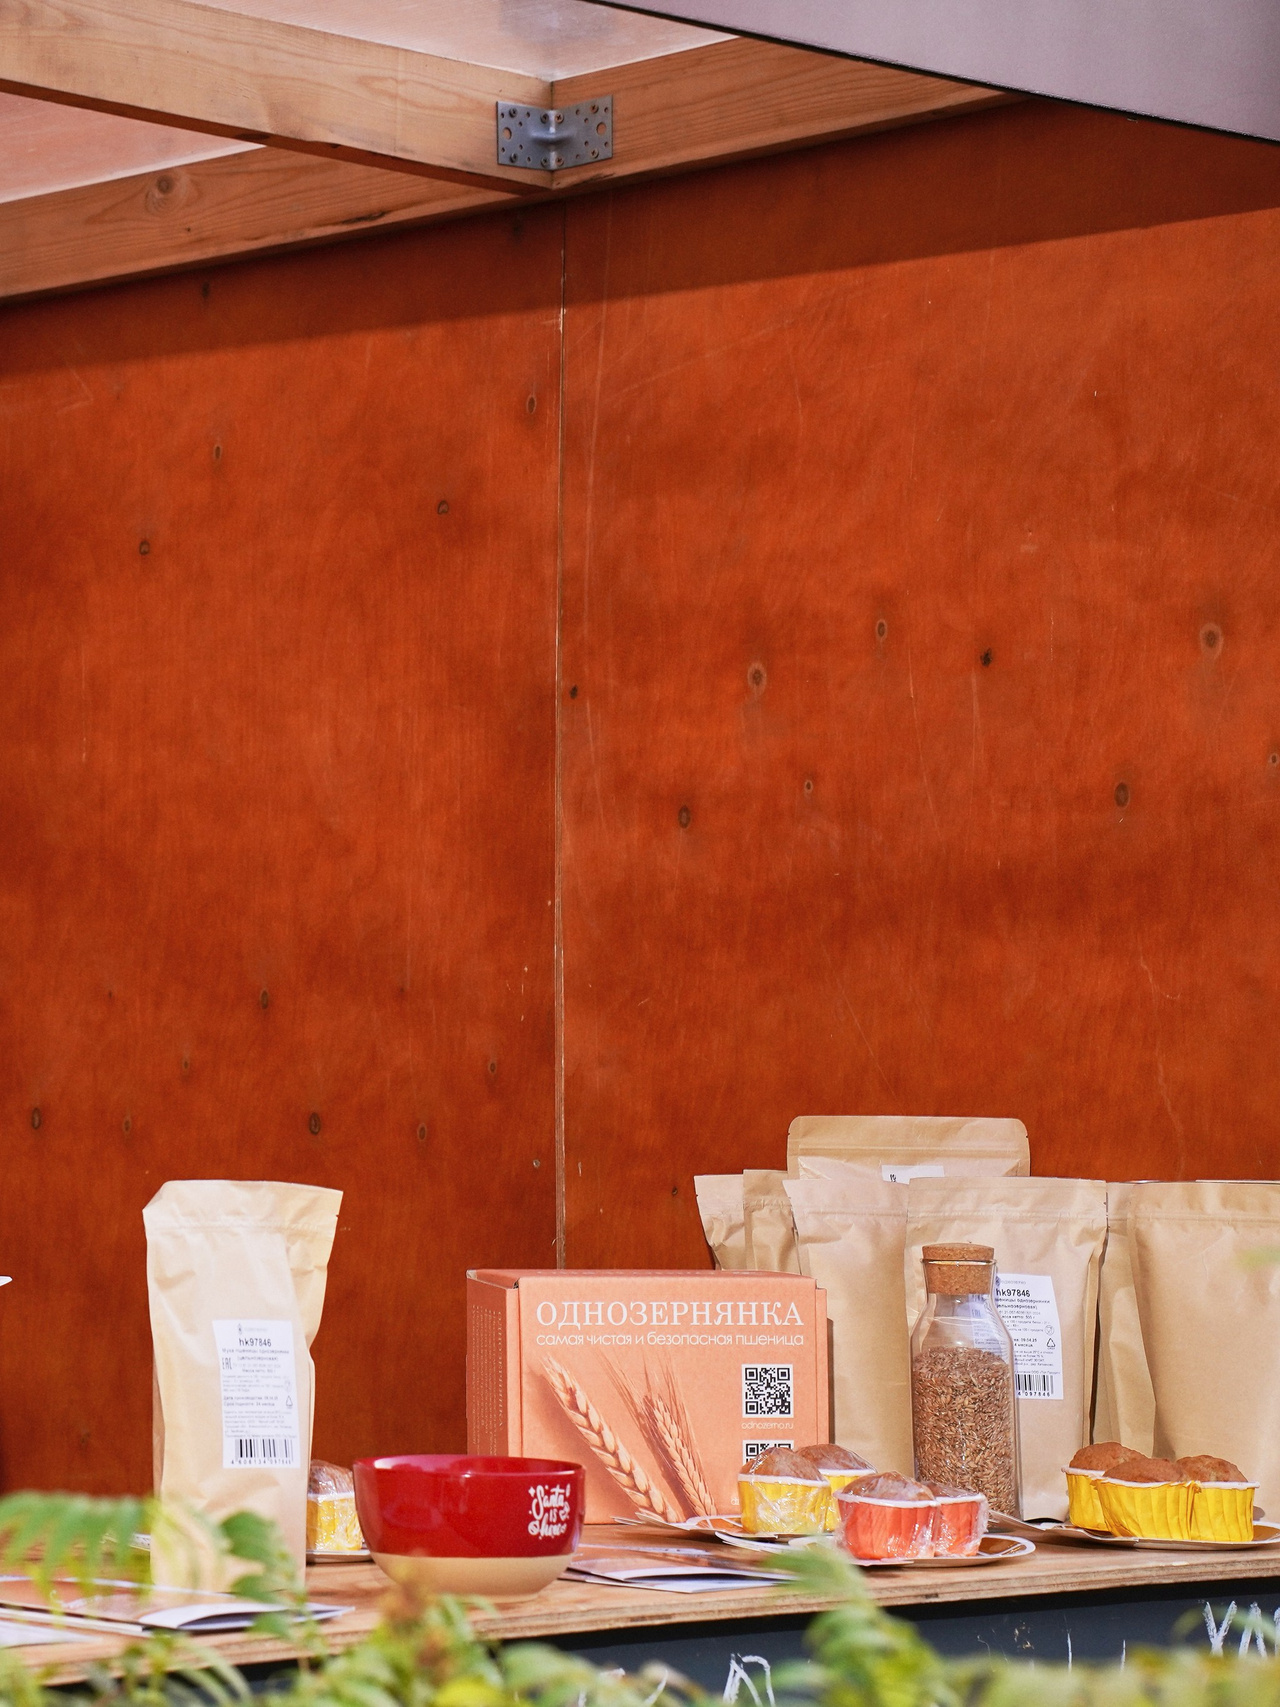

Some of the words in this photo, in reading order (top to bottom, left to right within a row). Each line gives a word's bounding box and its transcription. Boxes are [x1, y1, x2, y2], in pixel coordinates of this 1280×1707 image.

[996, 1288, 1031, 1297] hk97846
[536, 1301, 805, 1331] ОДНОЗЕРНЯНКА
[239, 1338, 272, 1347] hk97846
[536, 1335, 584, 1346] самая
[586, 1335, 632, 1346] чистая
[635, 1335, 644, 1345] и
[647, 1331, 733, 1346] безопасная
[735, 1335, 804, 1347] пшеница
[532, 1484, 565, 1521] Santa
